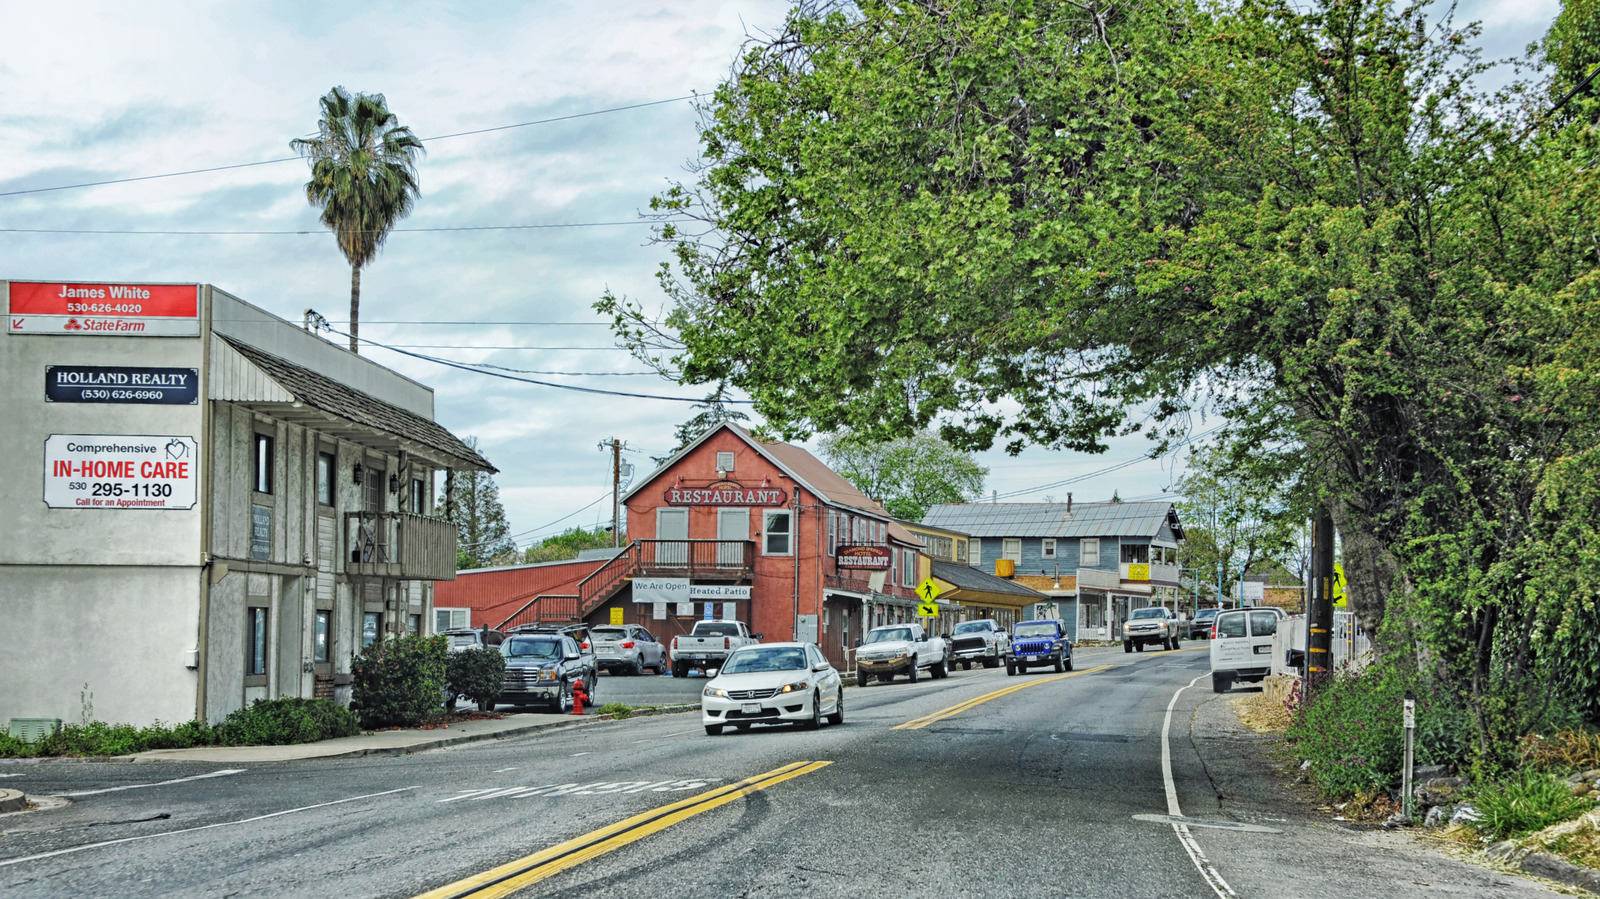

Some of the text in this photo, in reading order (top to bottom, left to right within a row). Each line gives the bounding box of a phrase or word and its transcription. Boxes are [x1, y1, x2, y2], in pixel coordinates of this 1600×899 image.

[58, 285, 151, 300] James White
[67, 303, 142, 313] 530-626-4020
[57, 371, 188, 386] HOLLAND REALTY
[81, 389, 163, 400] (530) 626-6960
[66, 442, 157, 455] Comprehensive
[53, 460, 189, 479] IN-HOME CARE
[69, 482, 172, 497] 530 295-1130
[75, 498, 91, 507] Call
[92, 498, 103, 507] for
[117, 499, 166, 508] Appointment
[670, 490, 780, 504] RESTAURANT
[838, 555, 889, 566] RESTAURANT
[634, 582, 647, 590] We
[665, 583, 687, 592] Open
[690, 587, 748, 596] Heated Patio
